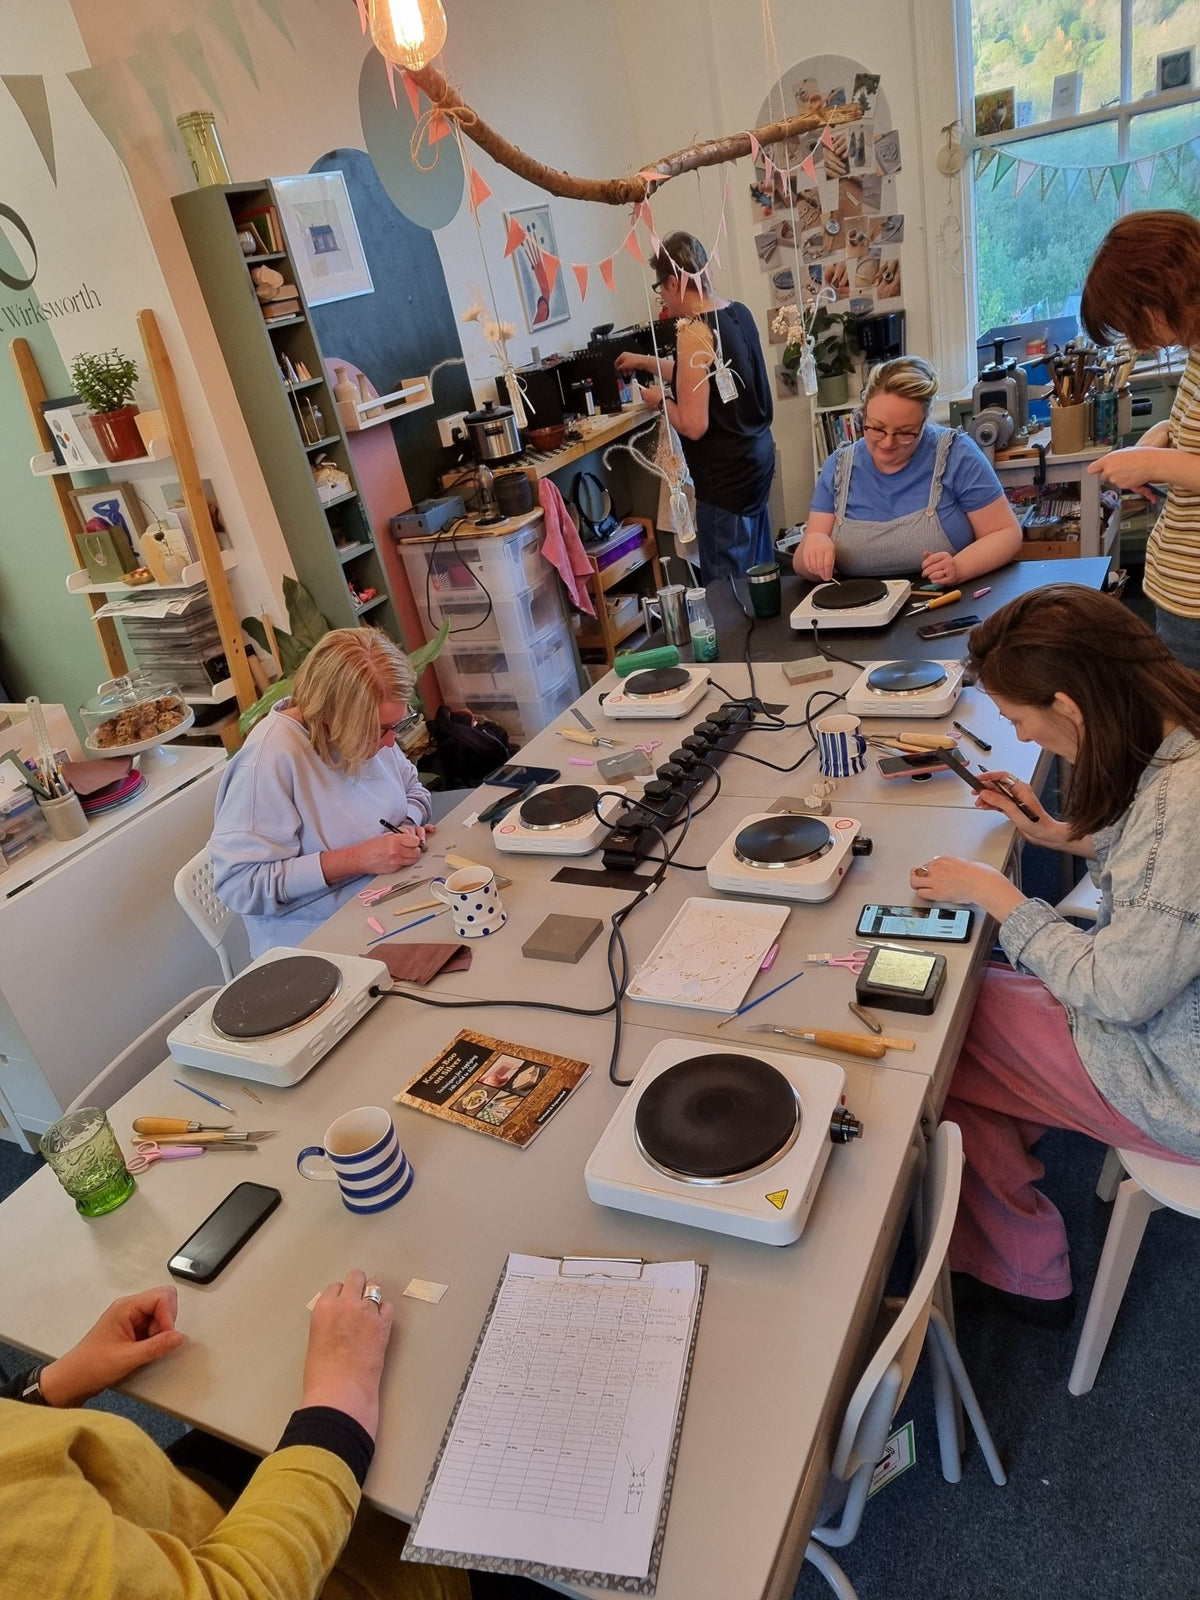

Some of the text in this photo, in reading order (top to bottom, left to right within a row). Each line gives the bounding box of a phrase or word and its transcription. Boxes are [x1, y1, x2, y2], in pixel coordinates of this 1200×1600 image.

[1, 282, 102, 328] Wirksworth
[433, 1057, 462, 1085] on Silver
